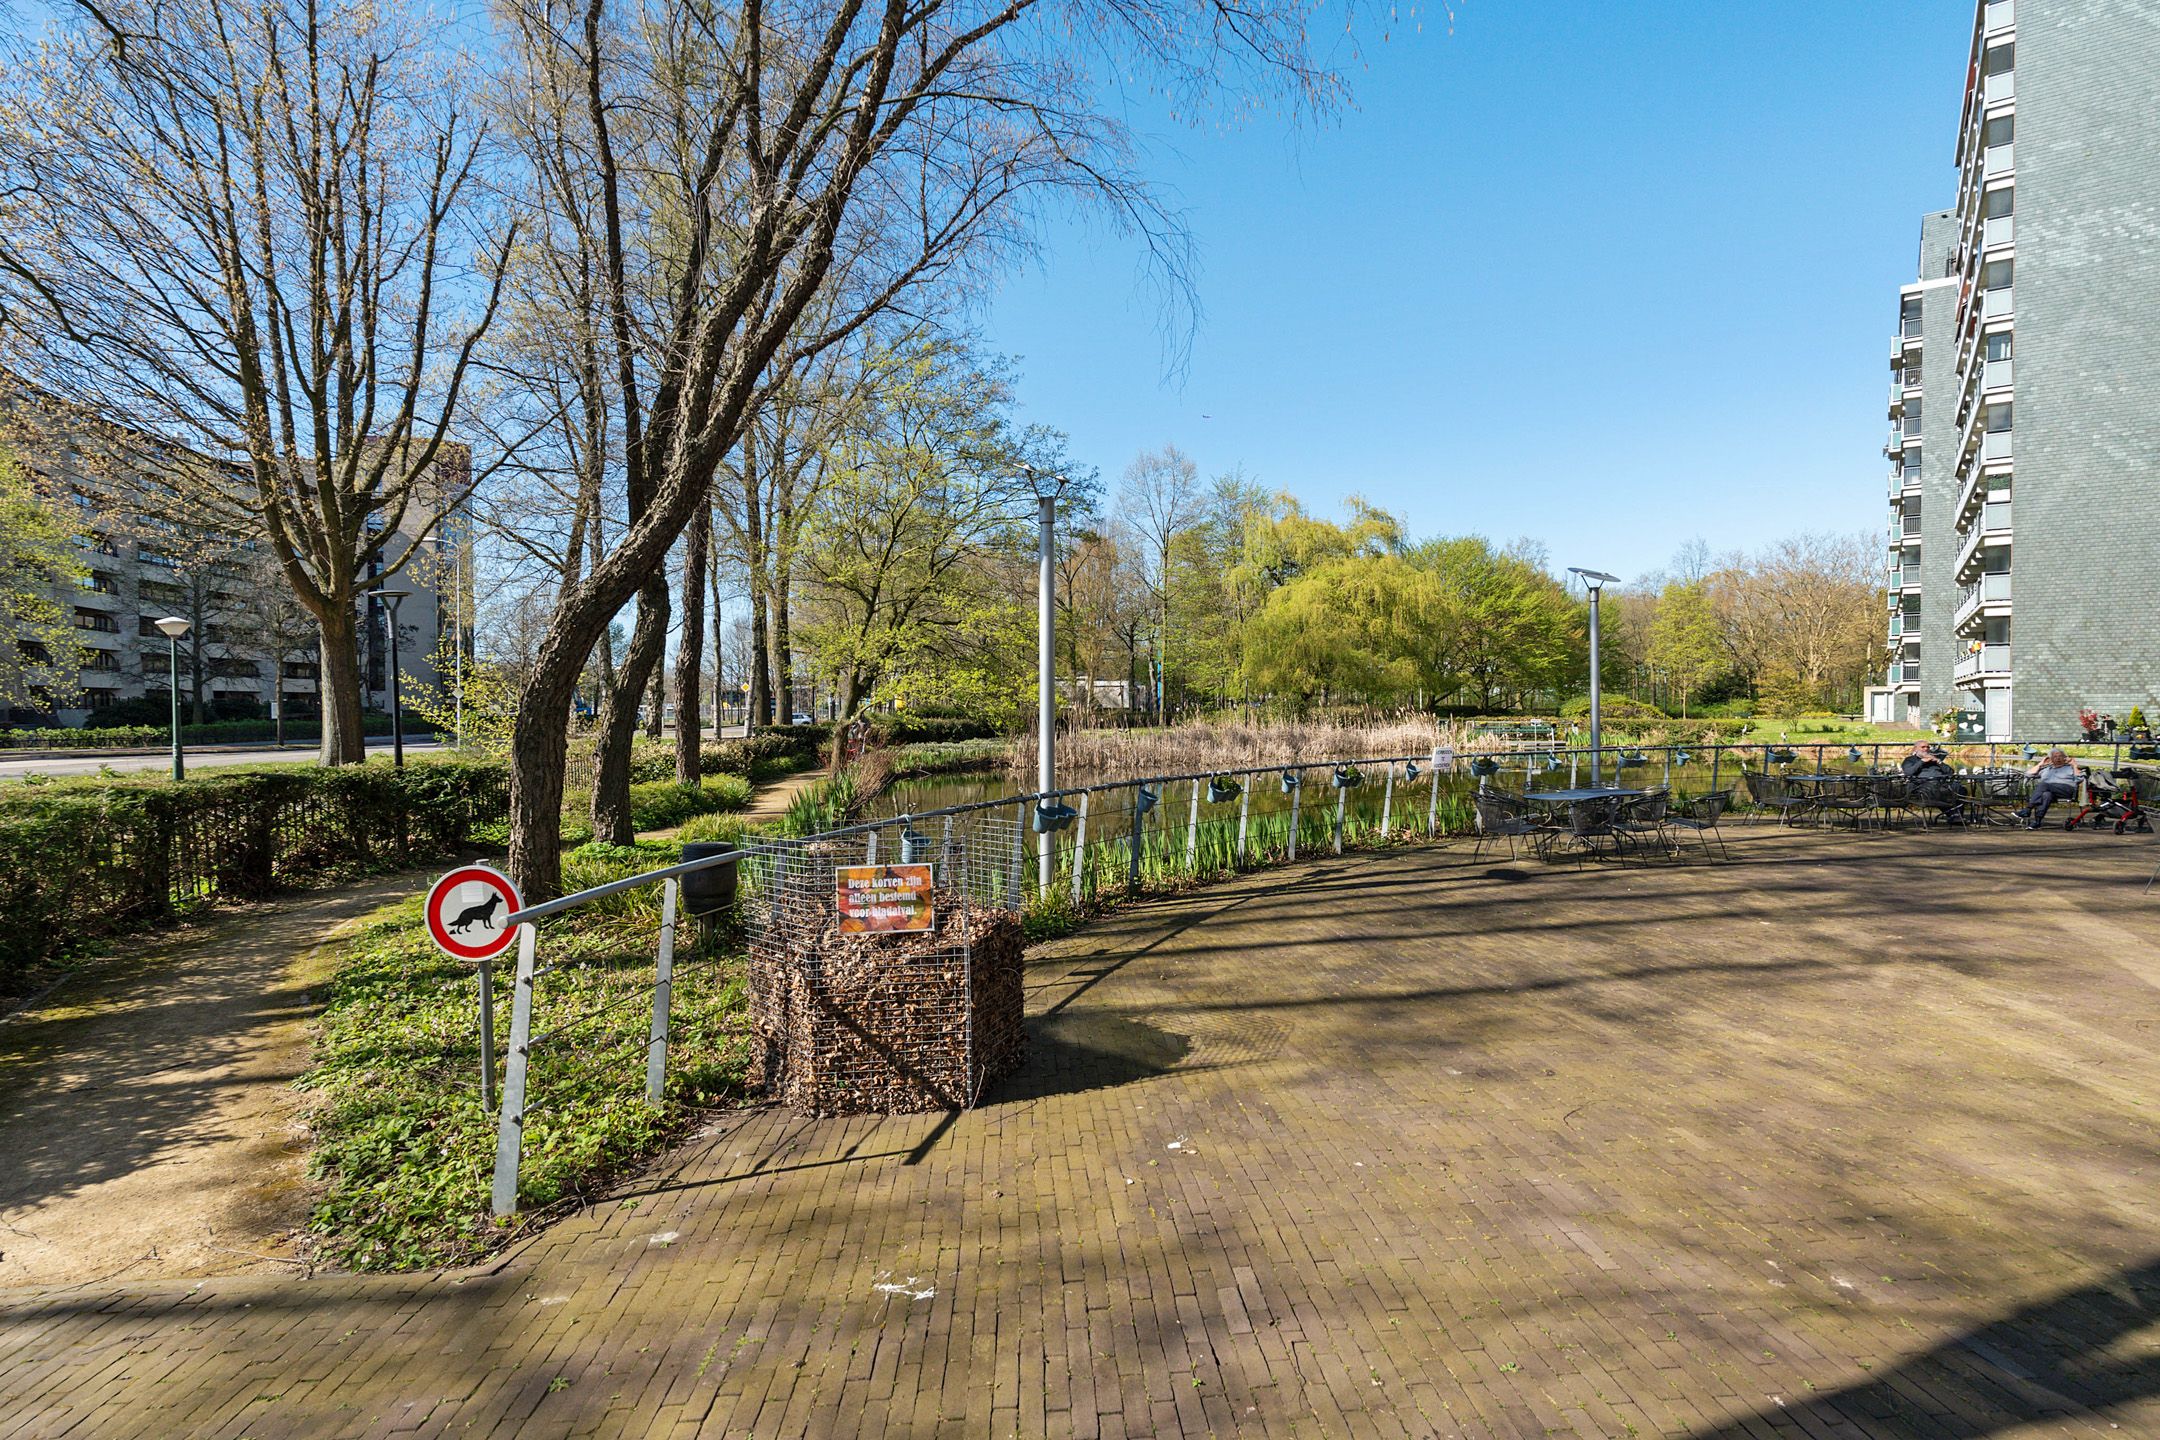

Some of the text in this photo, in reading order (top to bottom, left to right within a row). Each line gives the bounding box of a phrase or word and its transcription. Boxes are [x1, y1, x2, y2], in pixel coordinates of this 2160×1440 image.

[848, 876, 922, 888] Deze korven zijn
[848, 891, 917, 903] alleen bestemd
[848, 908, 870, 918] voor
